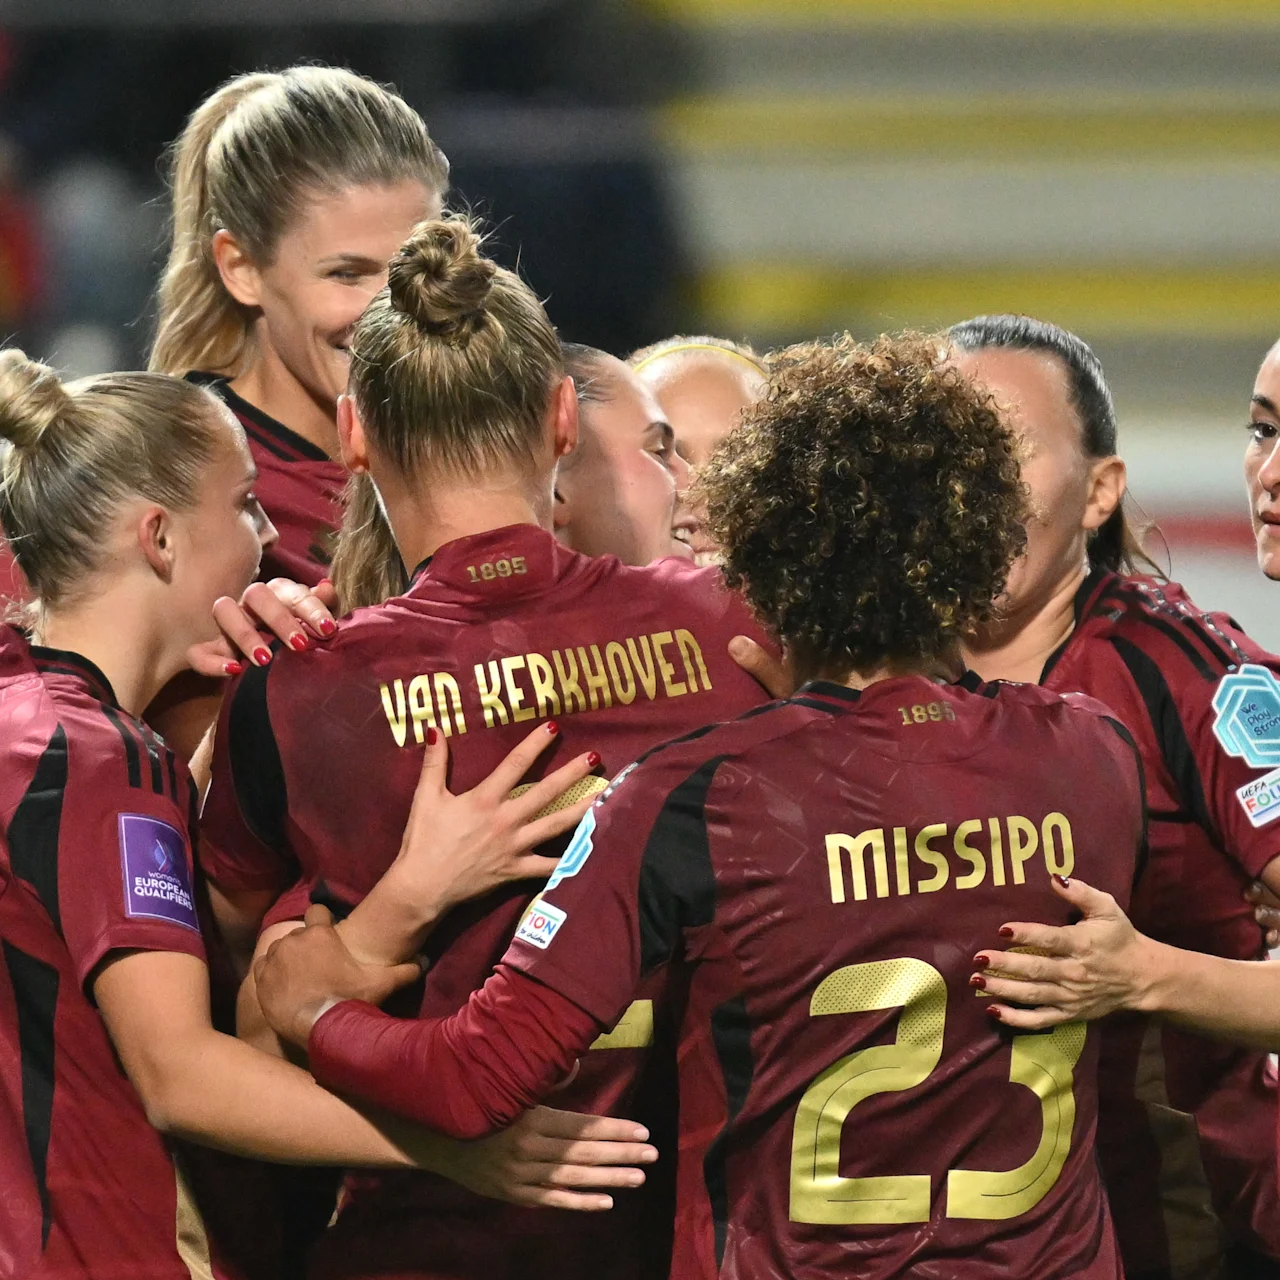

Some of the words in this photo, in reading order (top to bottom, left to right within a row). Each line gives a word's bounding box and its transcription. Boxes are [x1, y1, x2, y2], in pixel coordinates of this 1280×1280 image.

[466, 556, 528, 583] 1895
[379, 671, 467, 747] VAN
[474, 628, 713, 729] KERKHOVEN
[1241, 703, 1257, 715] We
[1241, 781, 1267, 800] UEFA
[824, 812, 1075, 904] MISSIPO
[134, 886, 193, 911] QUALIFIERS
[135, 877, 190, 900] EUROPEAN
[788, 946, 1088, 1224] 23
